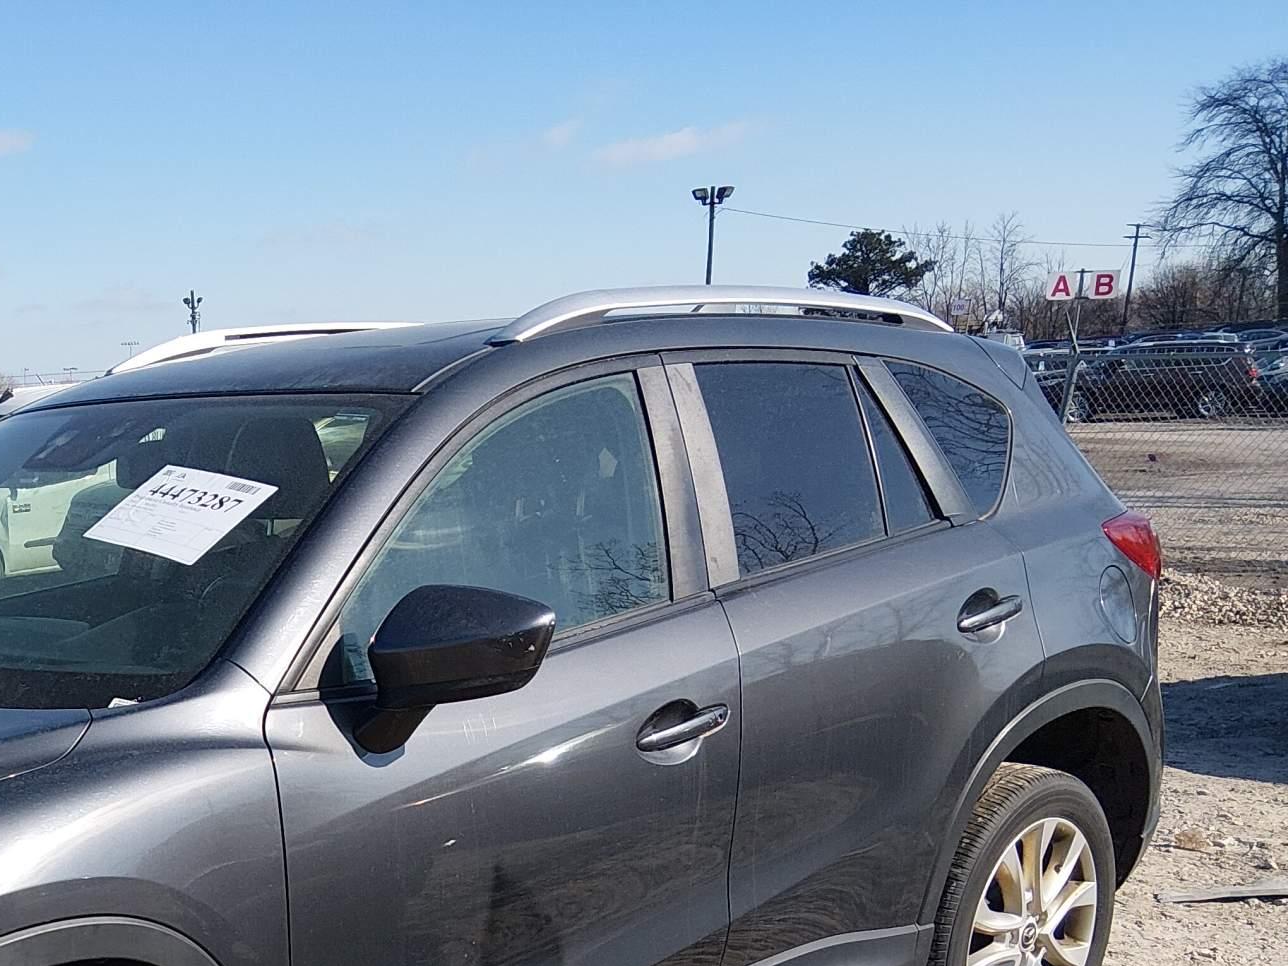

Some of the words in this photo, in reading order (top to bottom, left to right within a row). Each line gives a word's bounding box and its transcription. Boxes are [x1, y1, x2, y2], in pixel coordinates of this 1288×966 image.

[1050, 274, 1071, 297] A
[1094, 273, 1114, 296] B
[148, 483, 244, 513] 44473287
